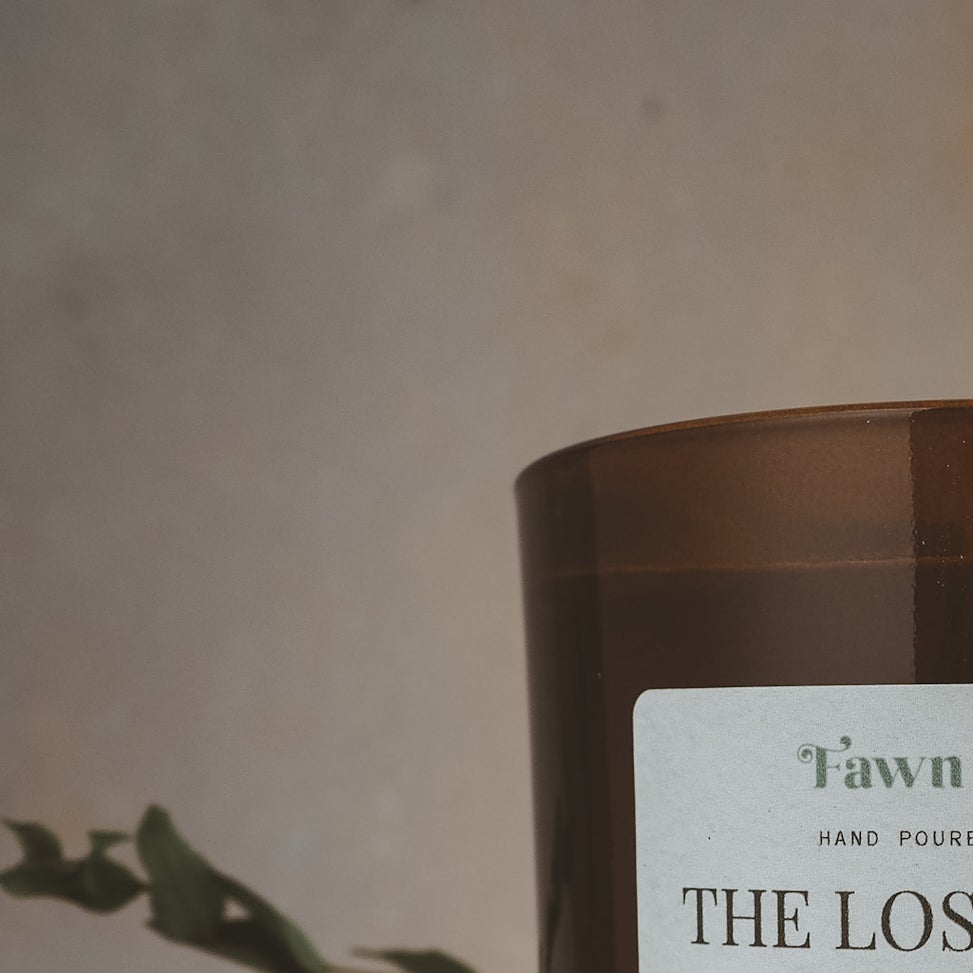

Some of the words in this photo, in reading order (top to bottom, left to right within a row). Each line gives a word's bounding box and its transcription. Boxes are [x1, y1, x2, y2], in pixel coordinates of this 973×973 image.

[797, 735, 962, 790] Fawn
[819, 830, 879, 847] HAND
[681, 886, 812, 950] THE
